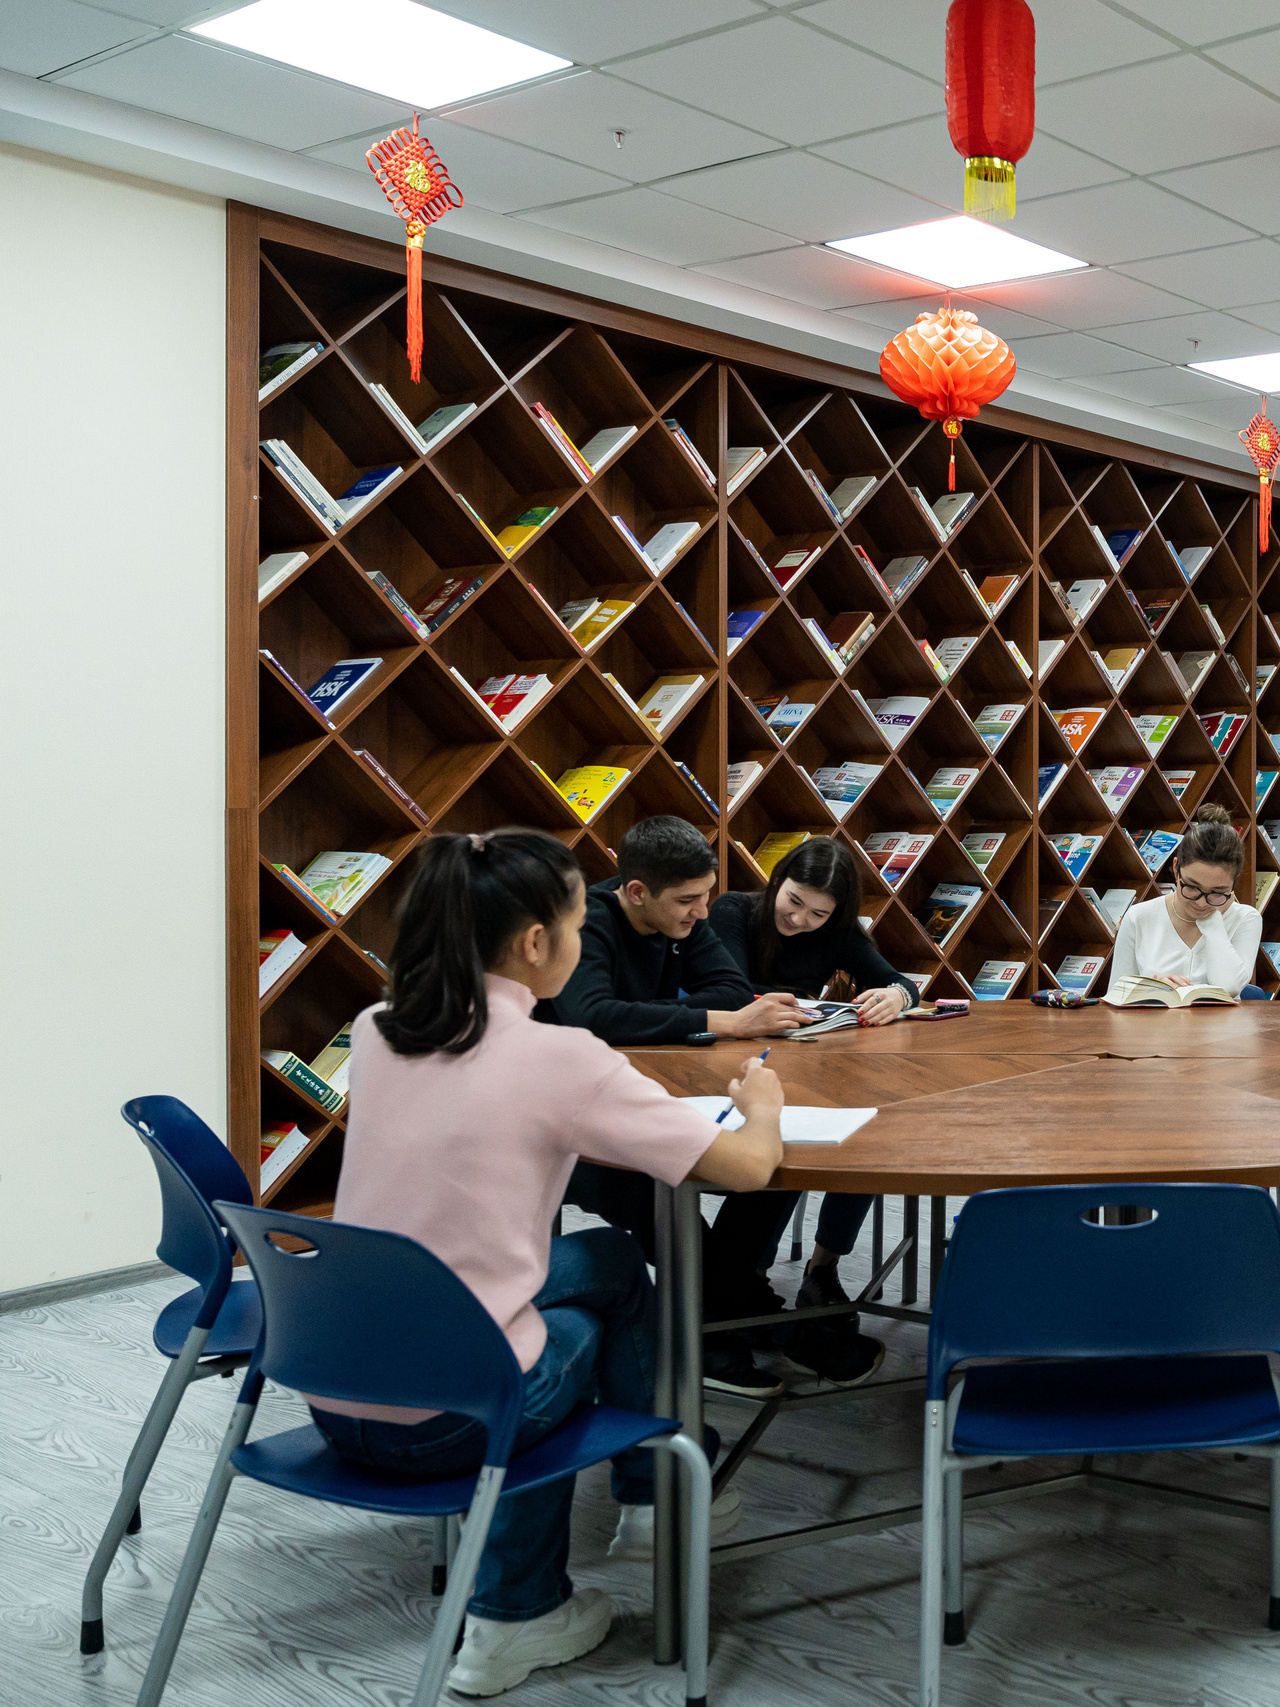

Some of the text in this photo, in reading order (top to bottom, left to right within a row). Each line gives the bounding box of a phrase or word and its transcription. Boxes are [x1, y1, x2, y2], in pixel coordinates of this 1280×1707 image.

[947, 420, 958, 435] 福
[310, 680, 349, 698] HSK
[778, 708, 804, 716] CHINA
[876, 714, 900, 725] HSK
[1161, 718, 1173, 726] 2
[1061, 723, 1087, 736] HSK
[602, 771, 616, 782] 2b
[1126, 770, 1137, 779] 6
